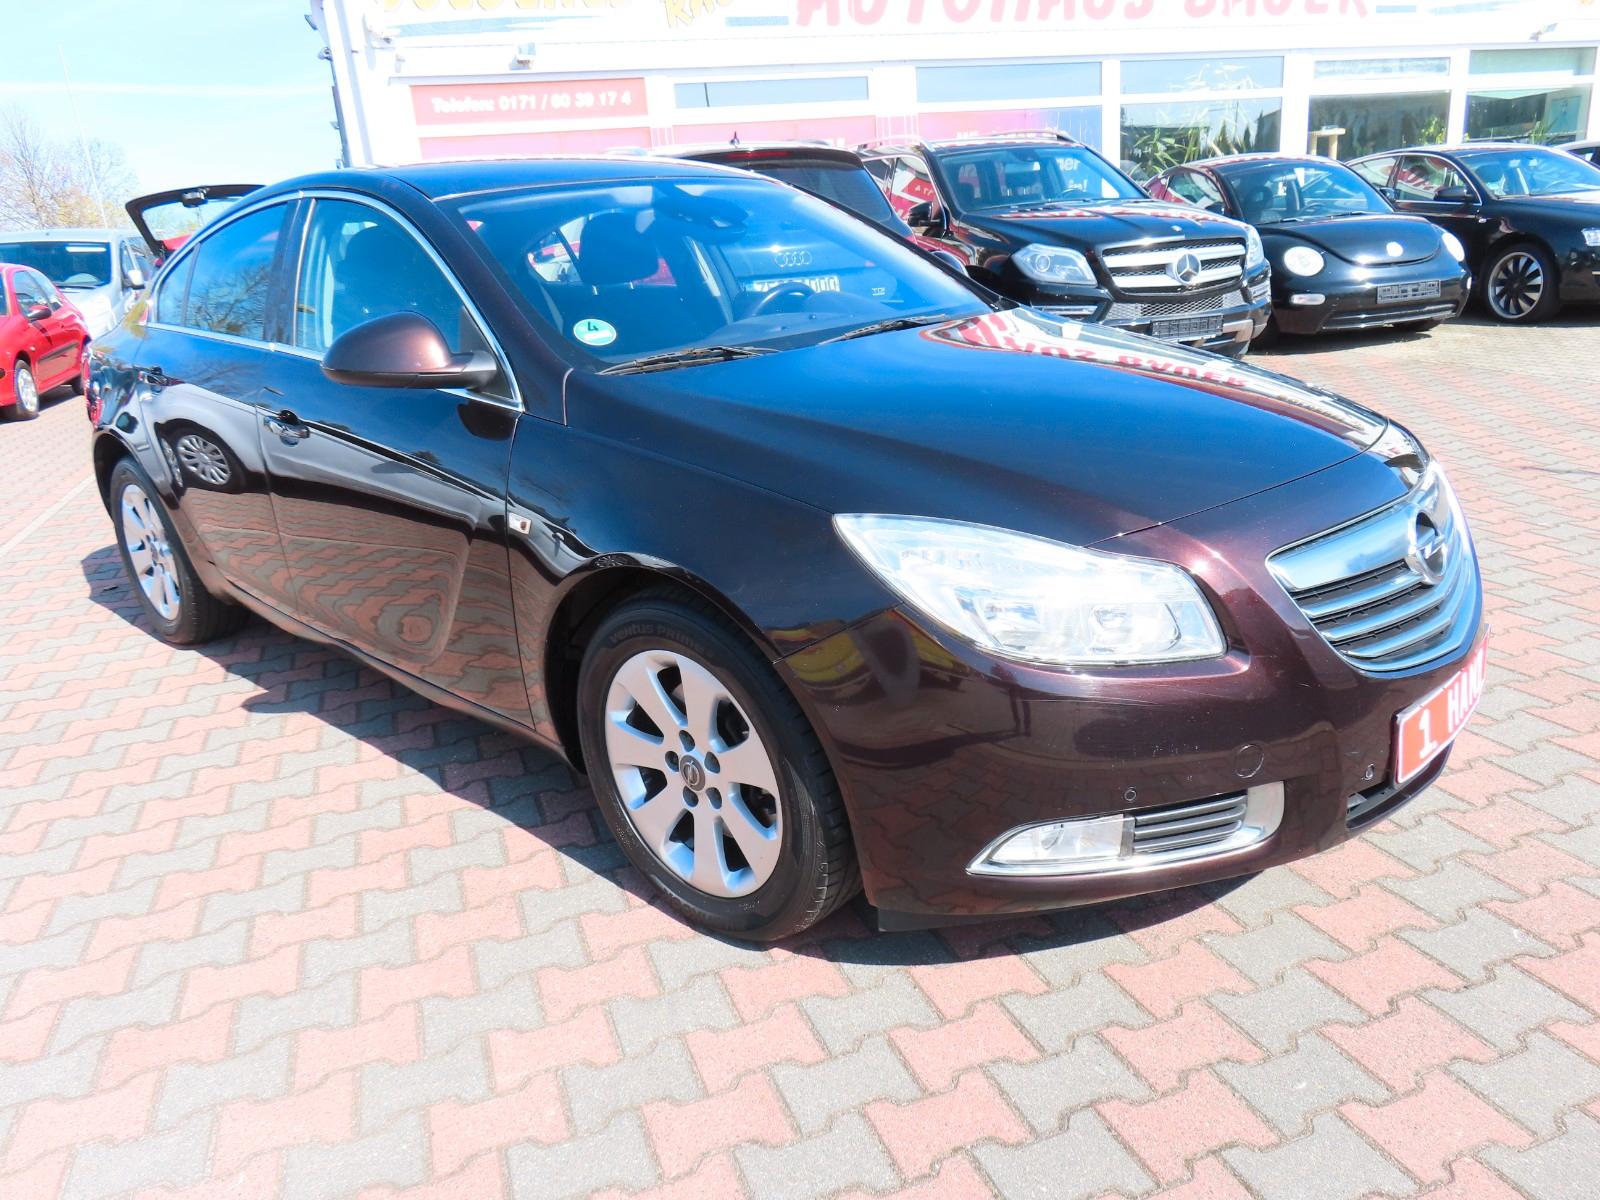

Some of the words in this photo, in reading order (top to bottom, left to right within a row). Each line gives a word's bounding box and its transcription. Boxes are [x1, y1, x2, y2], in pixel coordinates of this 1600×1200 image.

[498, 94, 536, 111] 0171
[541, 94, 549, 111] /
[599, 90, 618, 106] 17
[621, 89, 632, 106] 4
[588, 321, 599, 332] 4
